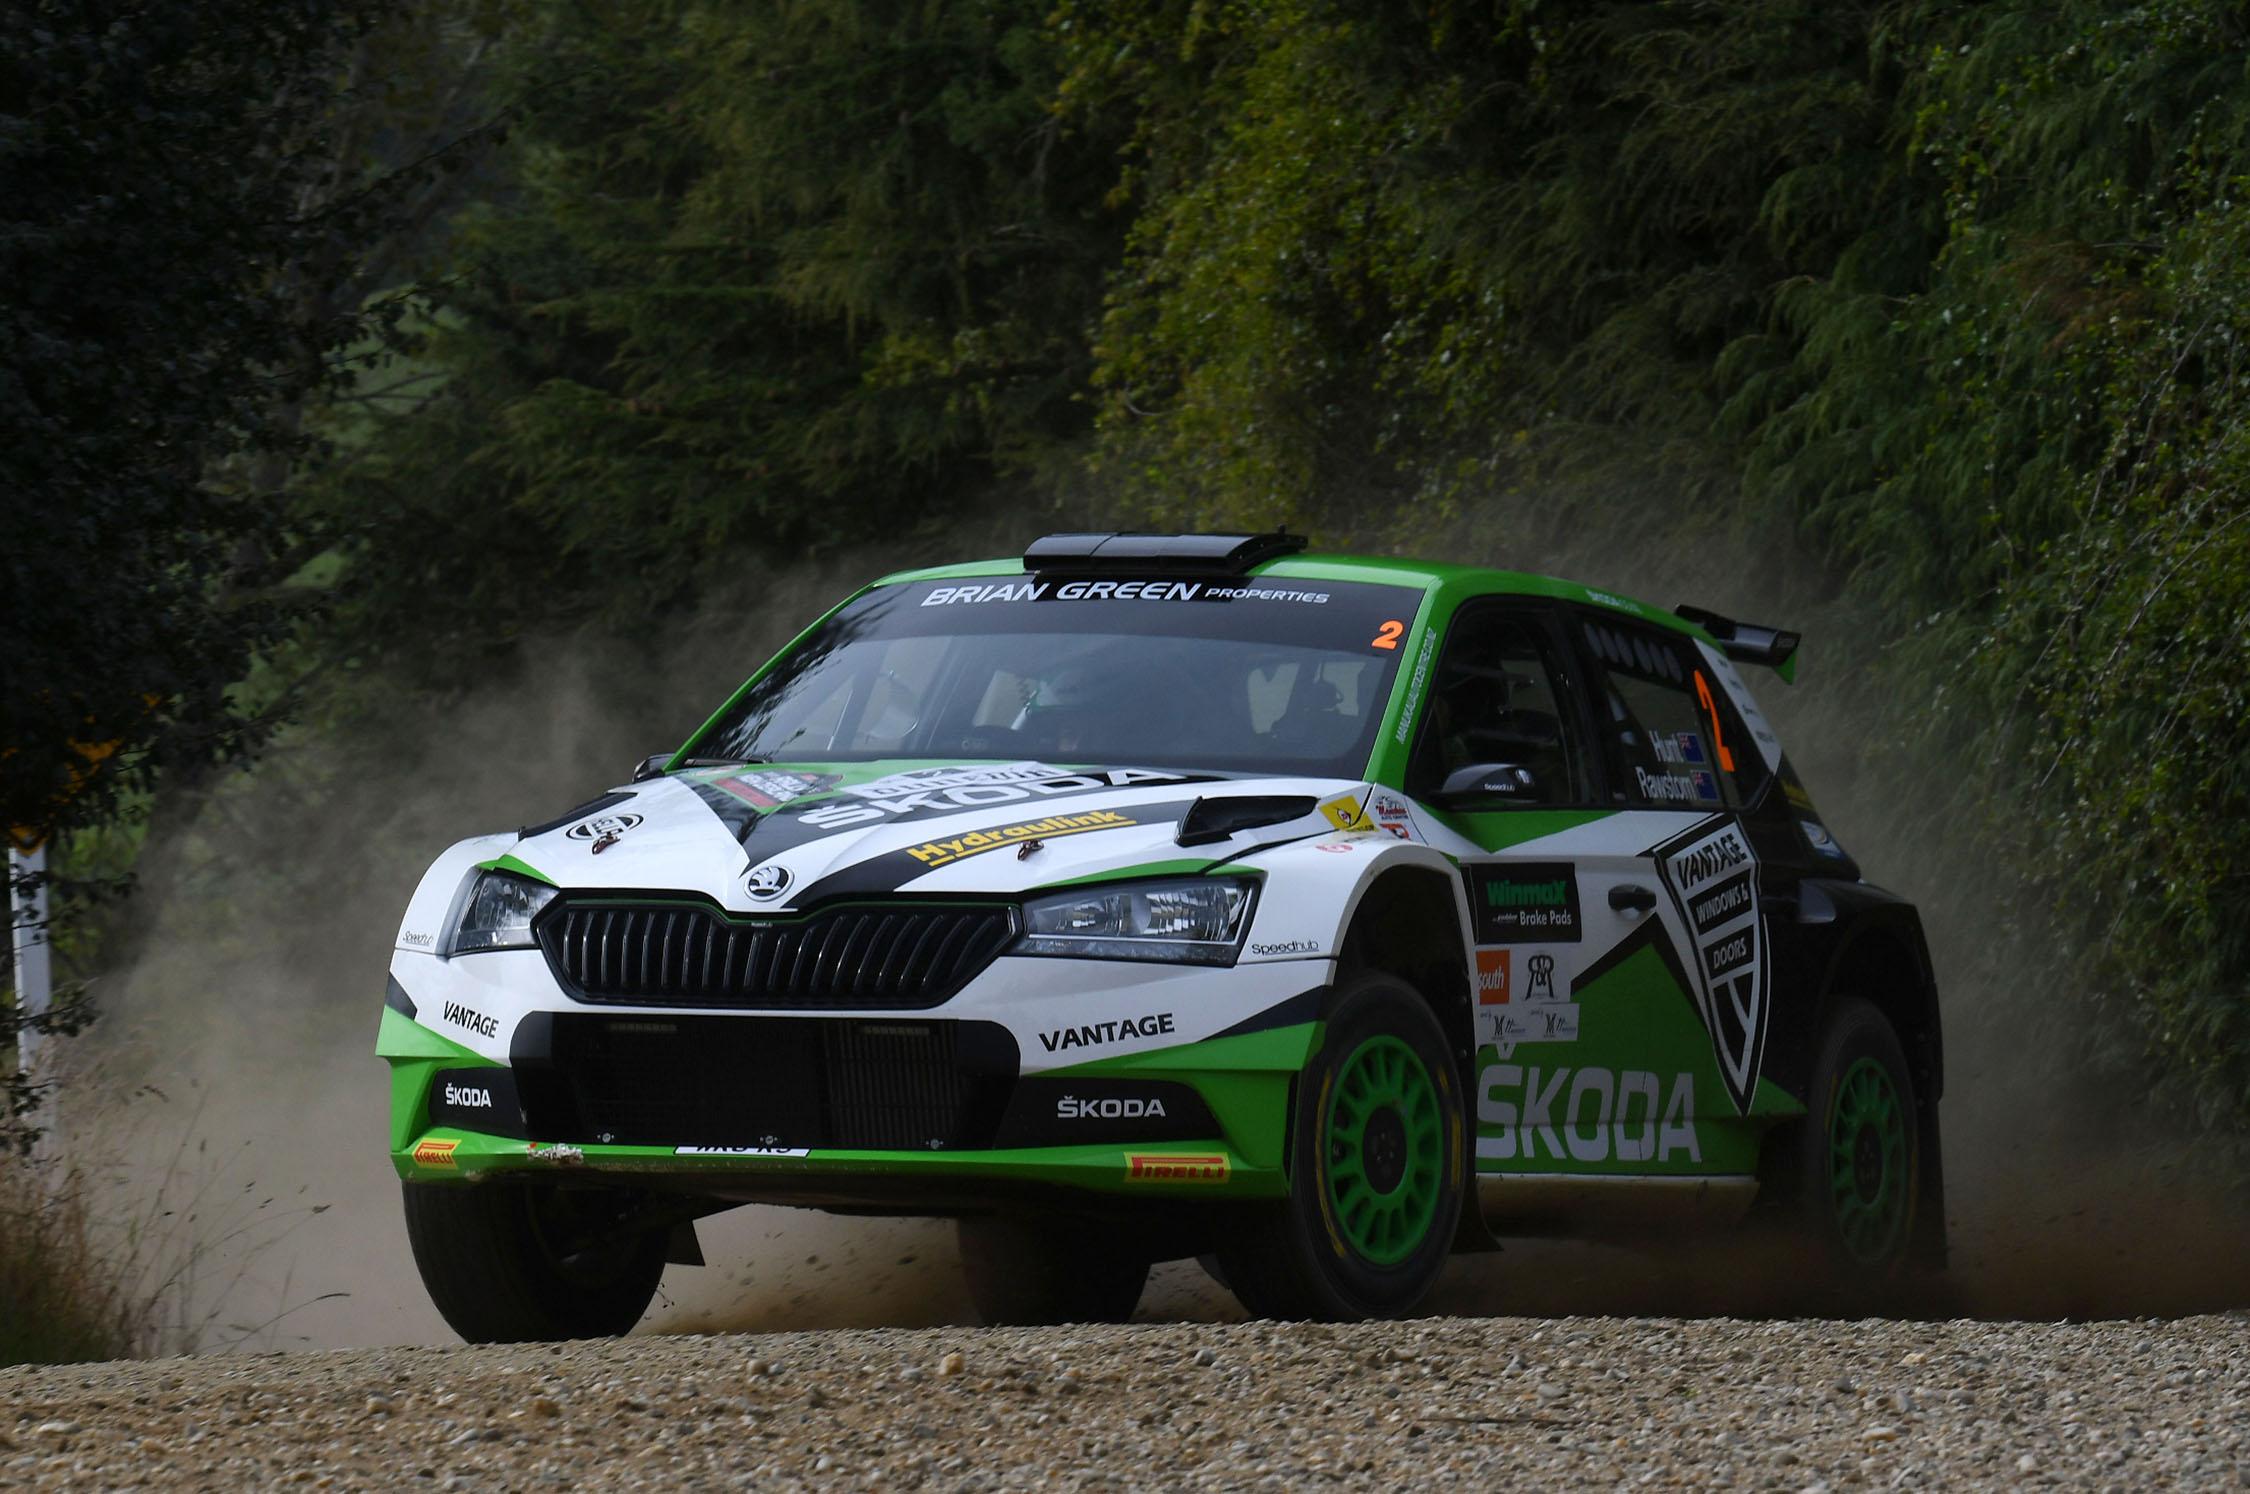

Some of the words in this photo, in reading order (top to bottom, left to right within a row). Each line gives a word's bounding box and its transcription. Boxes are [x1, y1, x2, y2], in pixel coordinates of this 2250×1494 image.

[921, 580, 1047, 607] BRIAN
[1056, 580, 1202, 602] GREEN
[1204, 586, 1331, 604] PROPERTIES
[1371, 619, 1404, 651] 2
[1692, 668, 1737, 773] 2
[1648, 730, 1685, 762] Hunt
[907, 808, 1131, 864] Hydraulink
[1677, 833, 1748, 890] VANTAGE
[1520, 909, 1547, 926] Brake
[1550, 909, 1572, 926] Pads
[1695, 886, 1740, 925] WINDOWS
[1251, 940, 1320, 955] Speedhub
[1712, 936, 1748, 971] DOORS
[443, 1000, 499, 1039] VANTAGE
[1039, 1013, 1175, 1052] VANTAGE
[444, 1081, 492, 1109] ŠKODA
[1056, 1094, 1168, 1119] ŠKODA
[415, 1142, 456, 1164] PIRELLI
